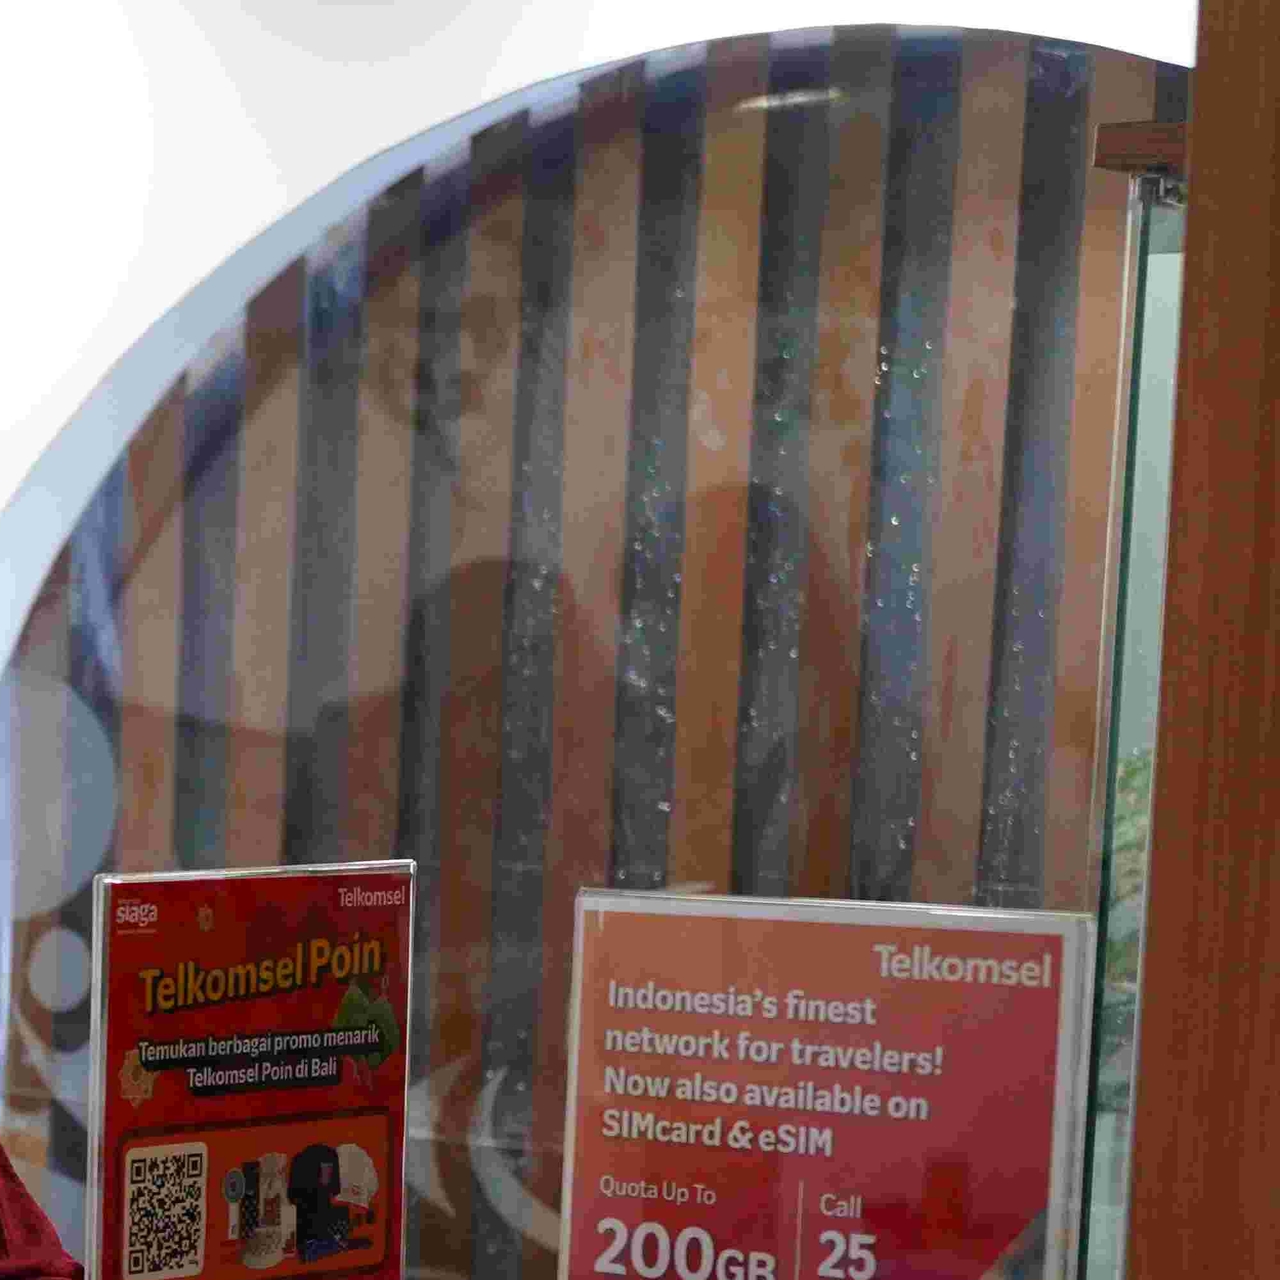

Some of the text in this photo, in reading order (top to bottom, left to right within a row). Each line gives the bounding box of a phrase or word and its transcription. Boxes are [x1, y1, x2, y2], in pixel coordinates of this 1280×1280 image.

[339, 886, 406, 908] Telkomsel
[139, 932, 383, 1013] Telkomsel Poin
[873, 944, 1052, 988] Telkomsel
[608, 980, 877, 1025] Indonesia's finest
[139, 1025, 380, 1061] Temukan berbagai promo menarik
[605, 1028, 944, 1075] network for travelers!
[187, 1057, 337, 1088] Telkomsel Poin di Bali
[605, 1068, 929, 1120] Now also available on
[601, 1110, 833, 1156] SIMcard & eSIM
[599, 1175, 717, 1206] Quota Up To
[819, 1194, 862, 1218] Call
[817, 1230, 878, 1280] 25
